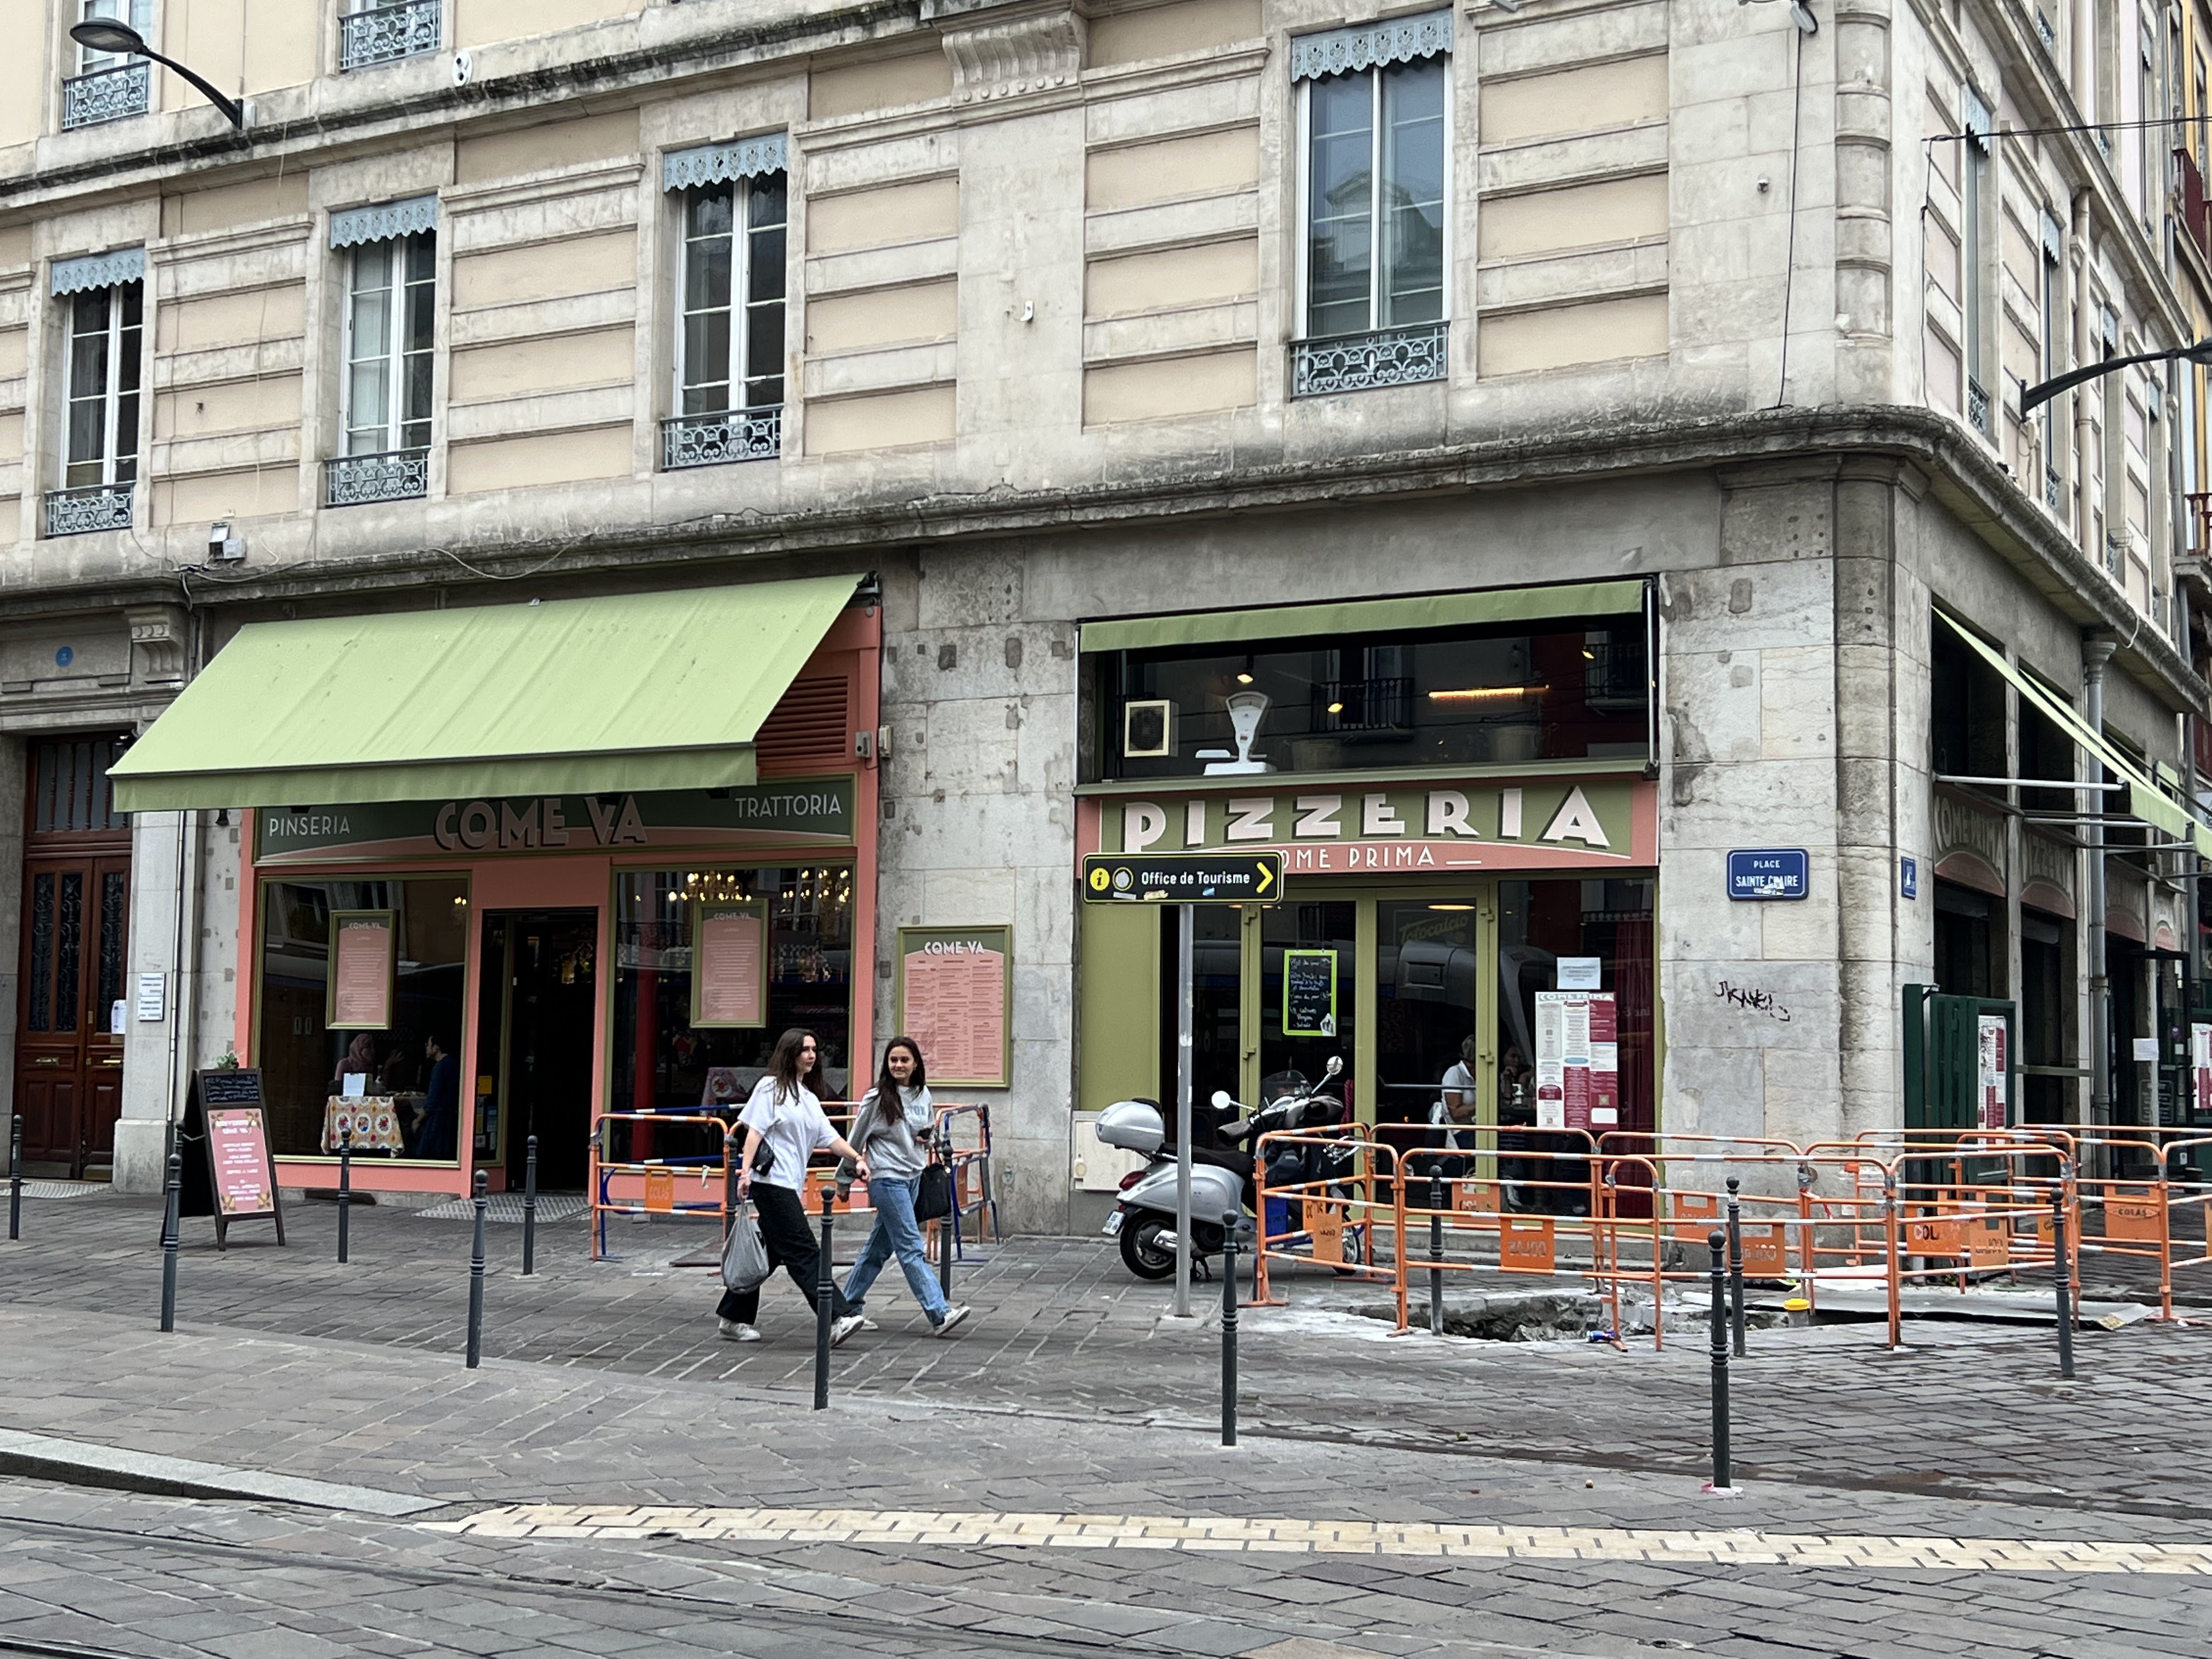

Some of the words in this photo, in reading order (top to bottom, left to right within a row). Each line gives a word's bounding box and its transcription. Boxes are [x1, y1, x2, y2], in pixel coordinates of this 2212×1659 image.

[735, 793, 842, 819] TRATTORIA
[269, 815, 350, 837] PINSERIA
[434, 798, 569, 851] COME
[585, 794, 648, 845] VA
[1124, 785, 1611, 853] PIZZERIA
[1280, 848, 1331, 869] OME
[1348, 845, 1435, 868] PRIMA
[1753, 860, 1781, 869] PLACE
[1141, 871, 1177, 886] Office
[1180, 871, 1194, 885] de
[1197, 870, 1251, 885] Tourisme
[1735, 874, 1765, 887] SAINTE
[714, 912, 740, 921] COME
[740, 912, 751, 921] VA
[924, 941, 964, 956] COME
[967, 940, 985, 955] VA
[2118, 1207, 2147, 1216] COLAS
